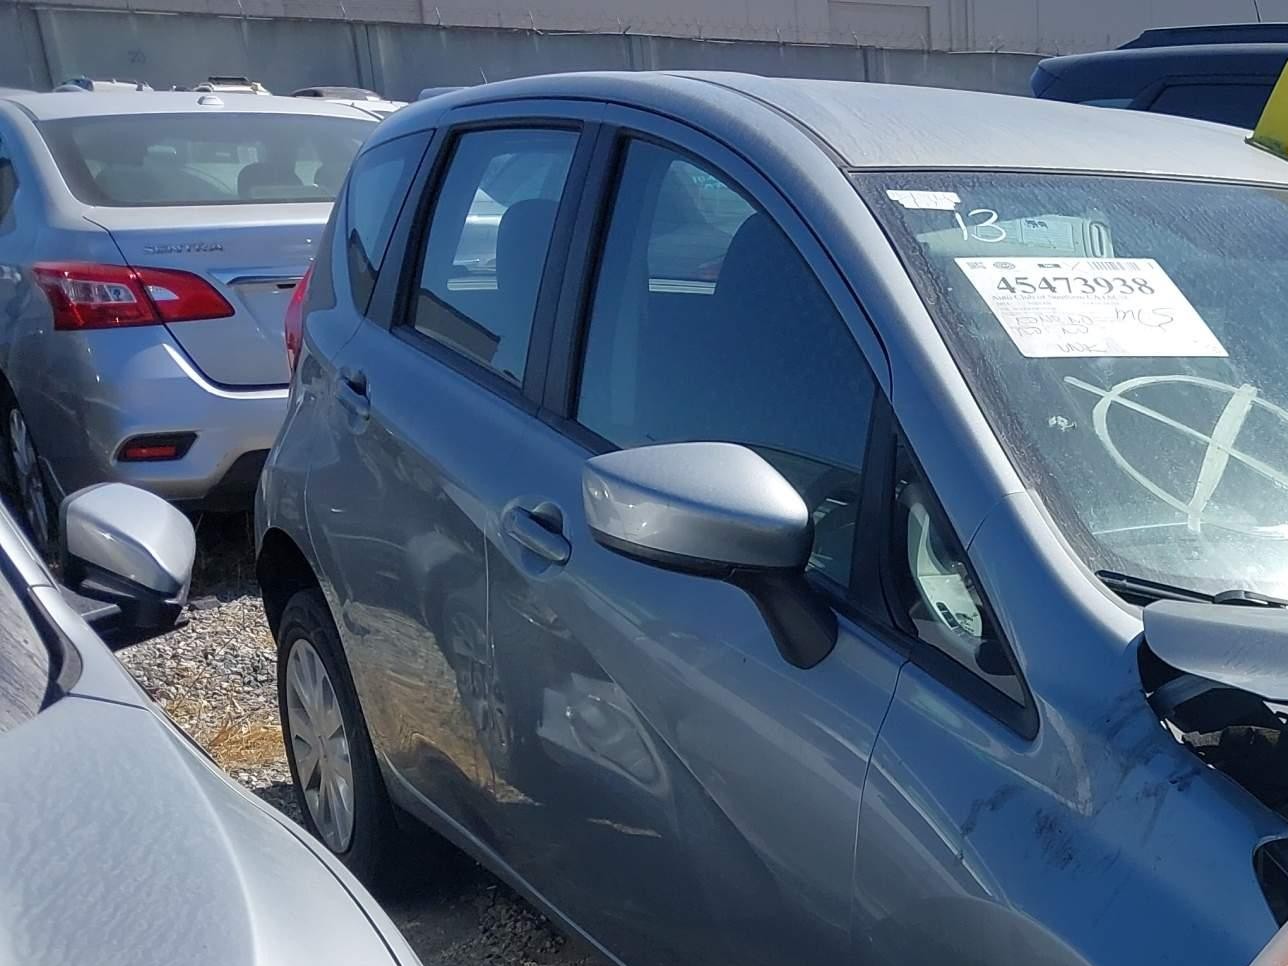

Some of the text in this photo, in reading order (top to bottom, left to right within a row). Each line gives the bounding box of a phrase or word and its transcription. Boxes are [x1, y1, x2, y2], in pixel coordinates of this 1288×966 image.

[954, 208, 1007, 242] 13
[144, 243, 224, 254] SENTRA
[996, 276, 1155, 295] 45473938
